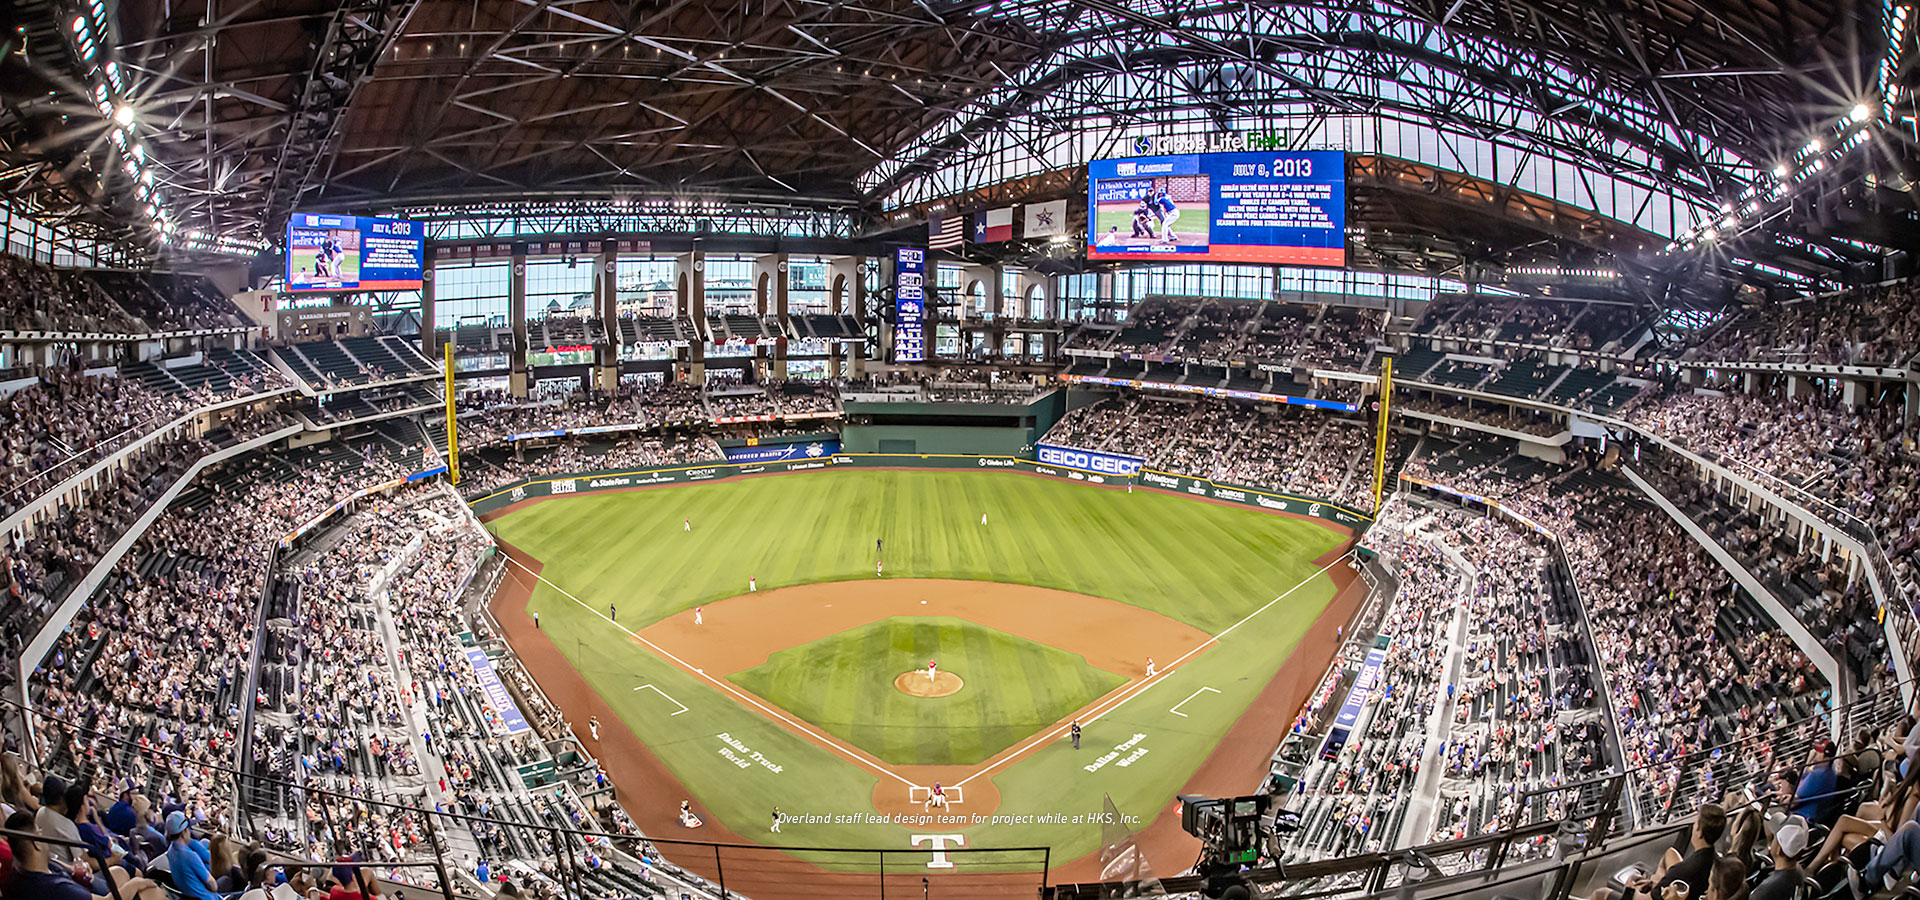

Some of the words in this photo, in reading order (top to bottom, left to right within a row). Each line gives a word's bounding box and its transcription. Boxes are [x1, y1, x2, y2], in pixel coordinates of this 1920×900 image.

[1157, 135, 1206, 152] Globe
[1210, 132, 1241, 149] Life
[1247, 130, 1288, 148] Field
[1233, 164, 1256, 176] JULY
[1258, 164, 1269, 177] 9,
[1273, 159, 1312, 177] 2013
[392, 222, 411, 235] 2013
[260, 295, 272, 312] T
[1039, 448, 1088, 470] GEICO
[1091, 454, 1142, 475] GEICO
[551, 484, 576, 494] SELTZER
[1152, 474, 1179, 485] National
[716, 732, 750, 753] Dallas
[749, 751, 783, 774] Truck
[718, 747, 751, 768] World
[1083, 751, 1119, 773] Dallas
[1114, 733, 1147, 752] Truck
[1115, 747, 1149, 767] World
[910, 834, 965, 869] T
